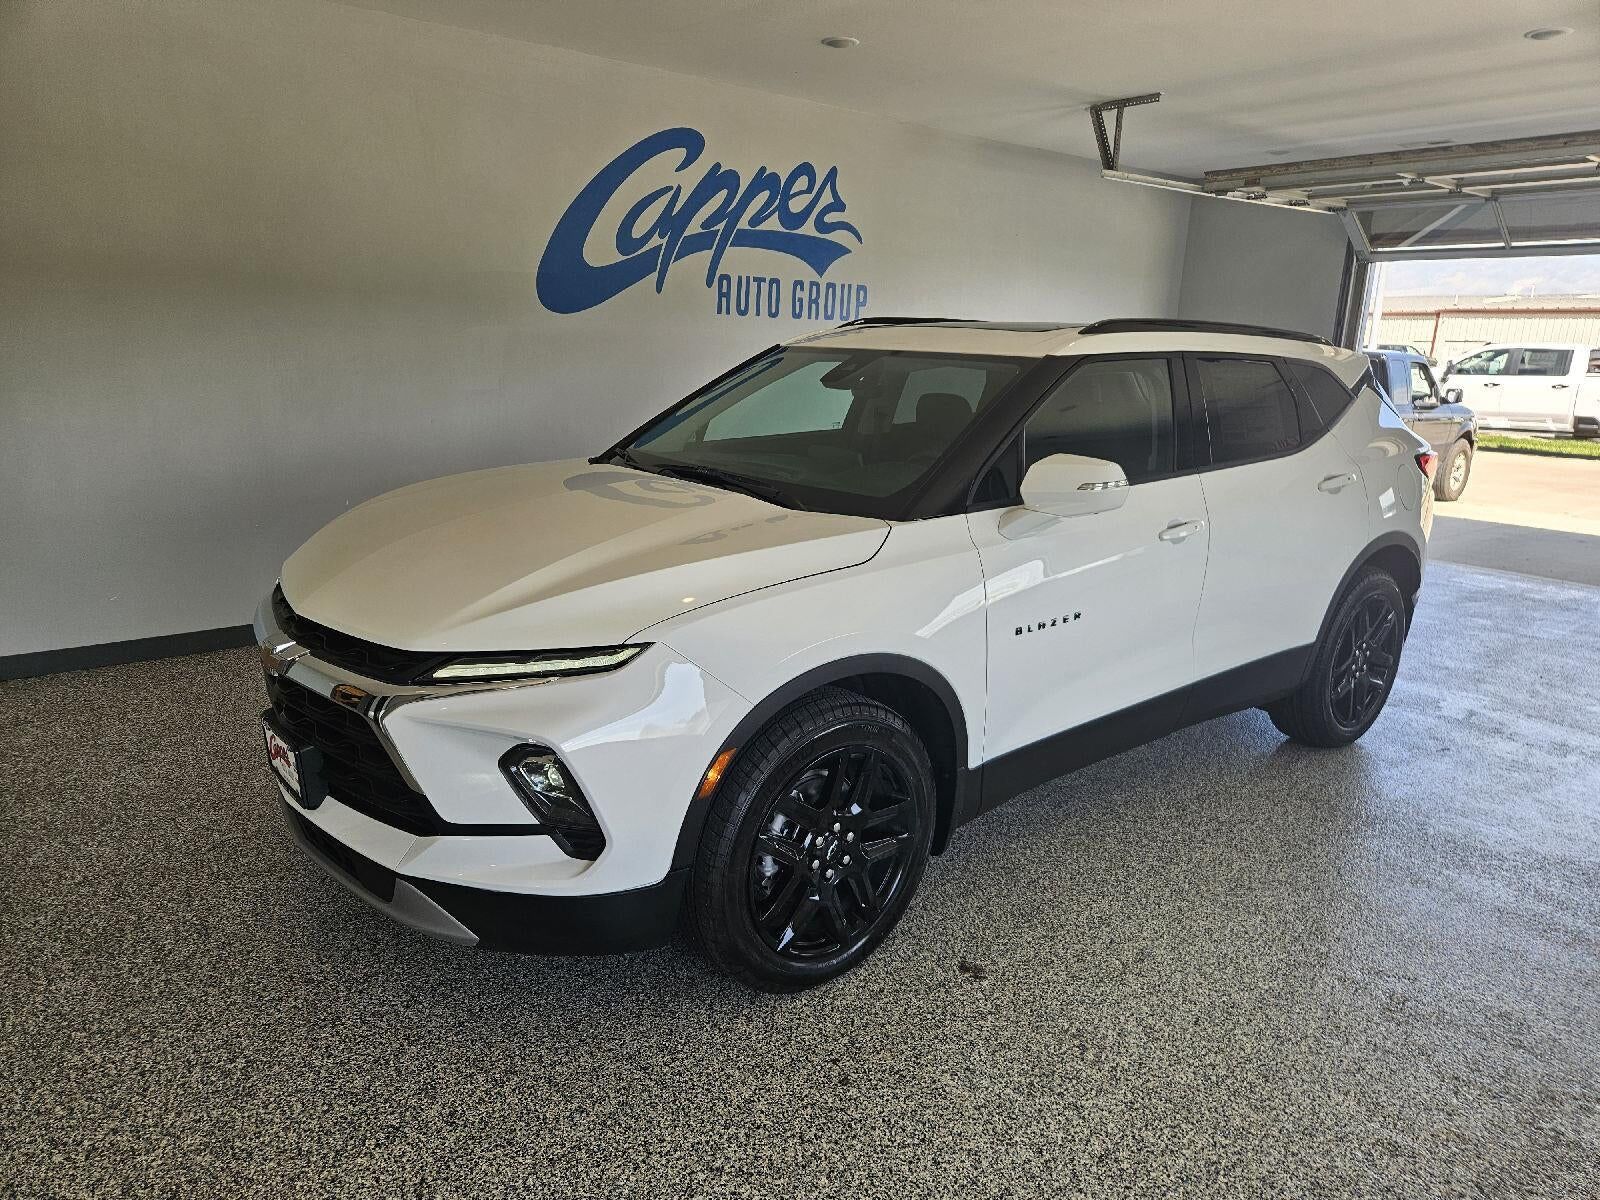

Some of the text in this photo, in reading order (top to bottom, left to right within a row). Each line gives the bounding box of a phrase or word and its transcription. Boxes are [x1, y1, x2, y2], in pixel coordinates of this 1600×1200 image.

[716, 273, 867, 321] AUTO GROUP
[1015, 611, 1082, 636] BLAZER
